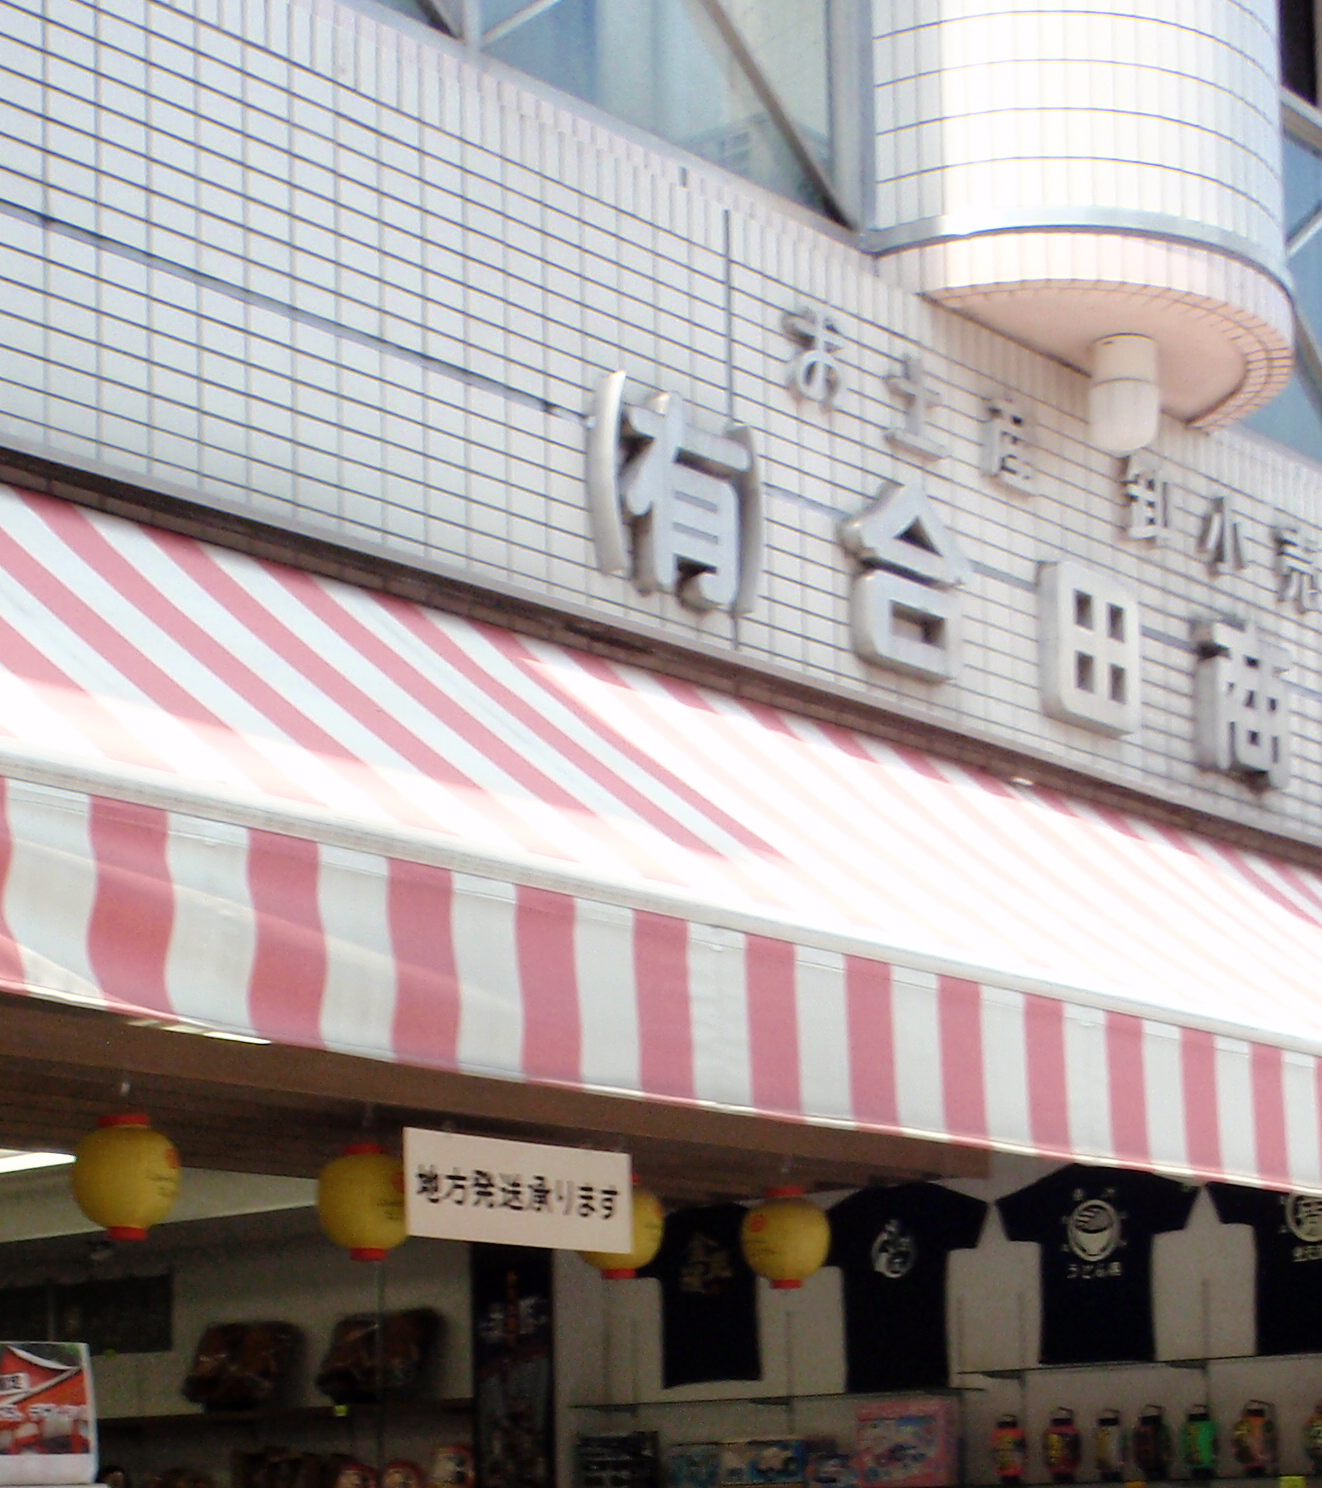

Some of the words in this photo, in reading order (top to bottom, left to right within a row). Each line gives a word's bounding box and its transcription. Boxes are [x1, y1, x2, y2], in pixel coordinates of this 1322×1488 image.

[414, 1163, 621, 1221] 地方発送承ります
